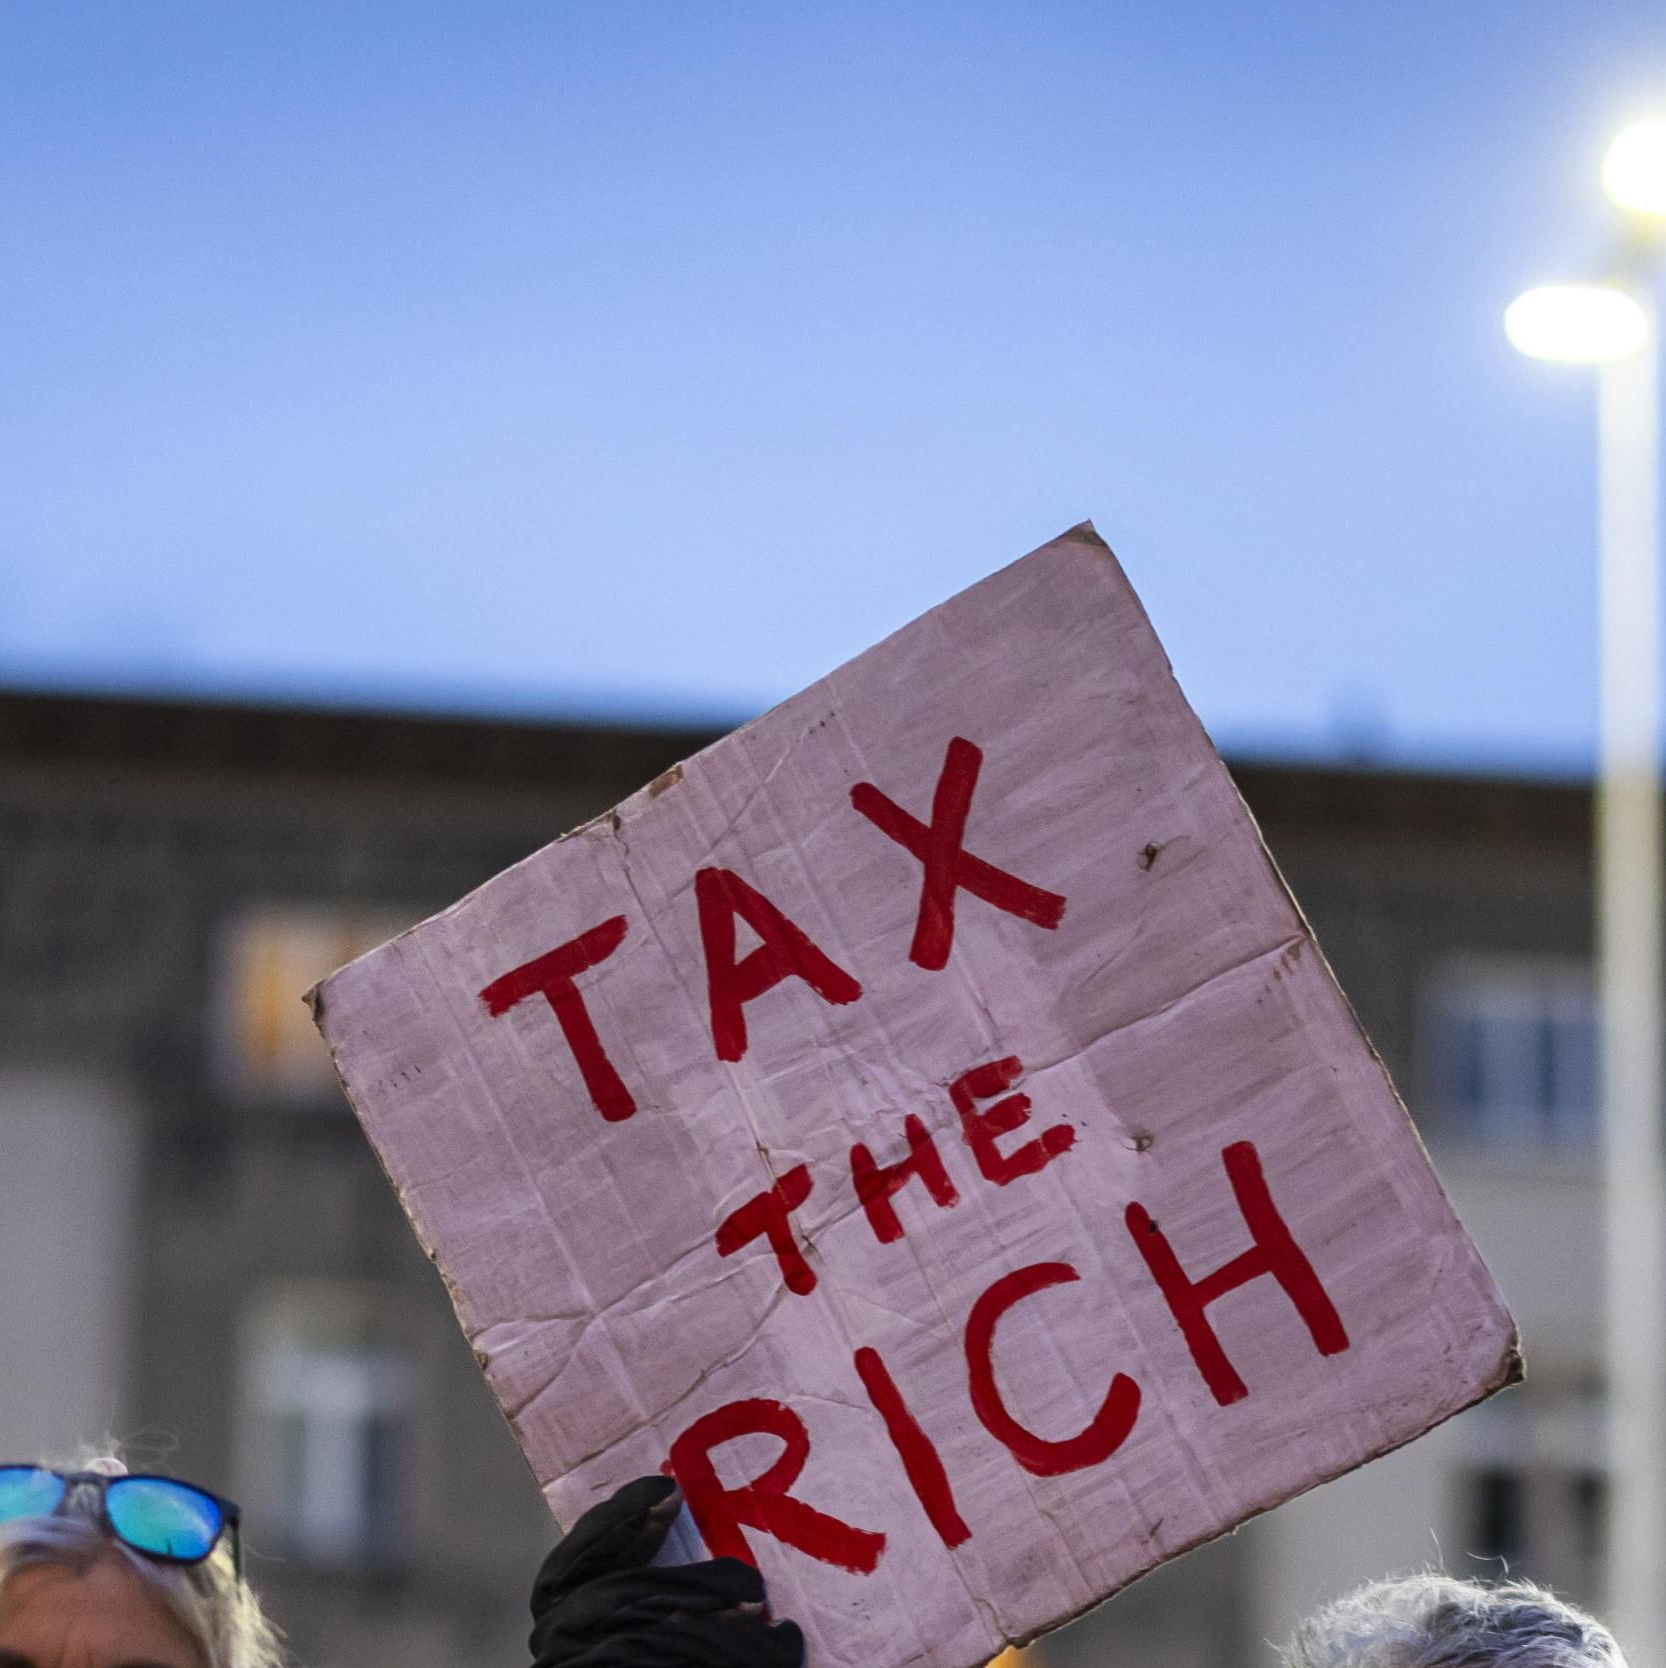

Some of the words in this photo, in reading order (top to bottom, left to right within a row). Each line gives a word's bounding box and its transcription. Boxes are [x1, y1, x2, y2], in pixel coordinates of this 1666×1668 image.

[478, 736, 1067, 1121] TAX
[716, 1055, 1078, 1296] THE
[661, 1140, 1350, 1622] RICH
